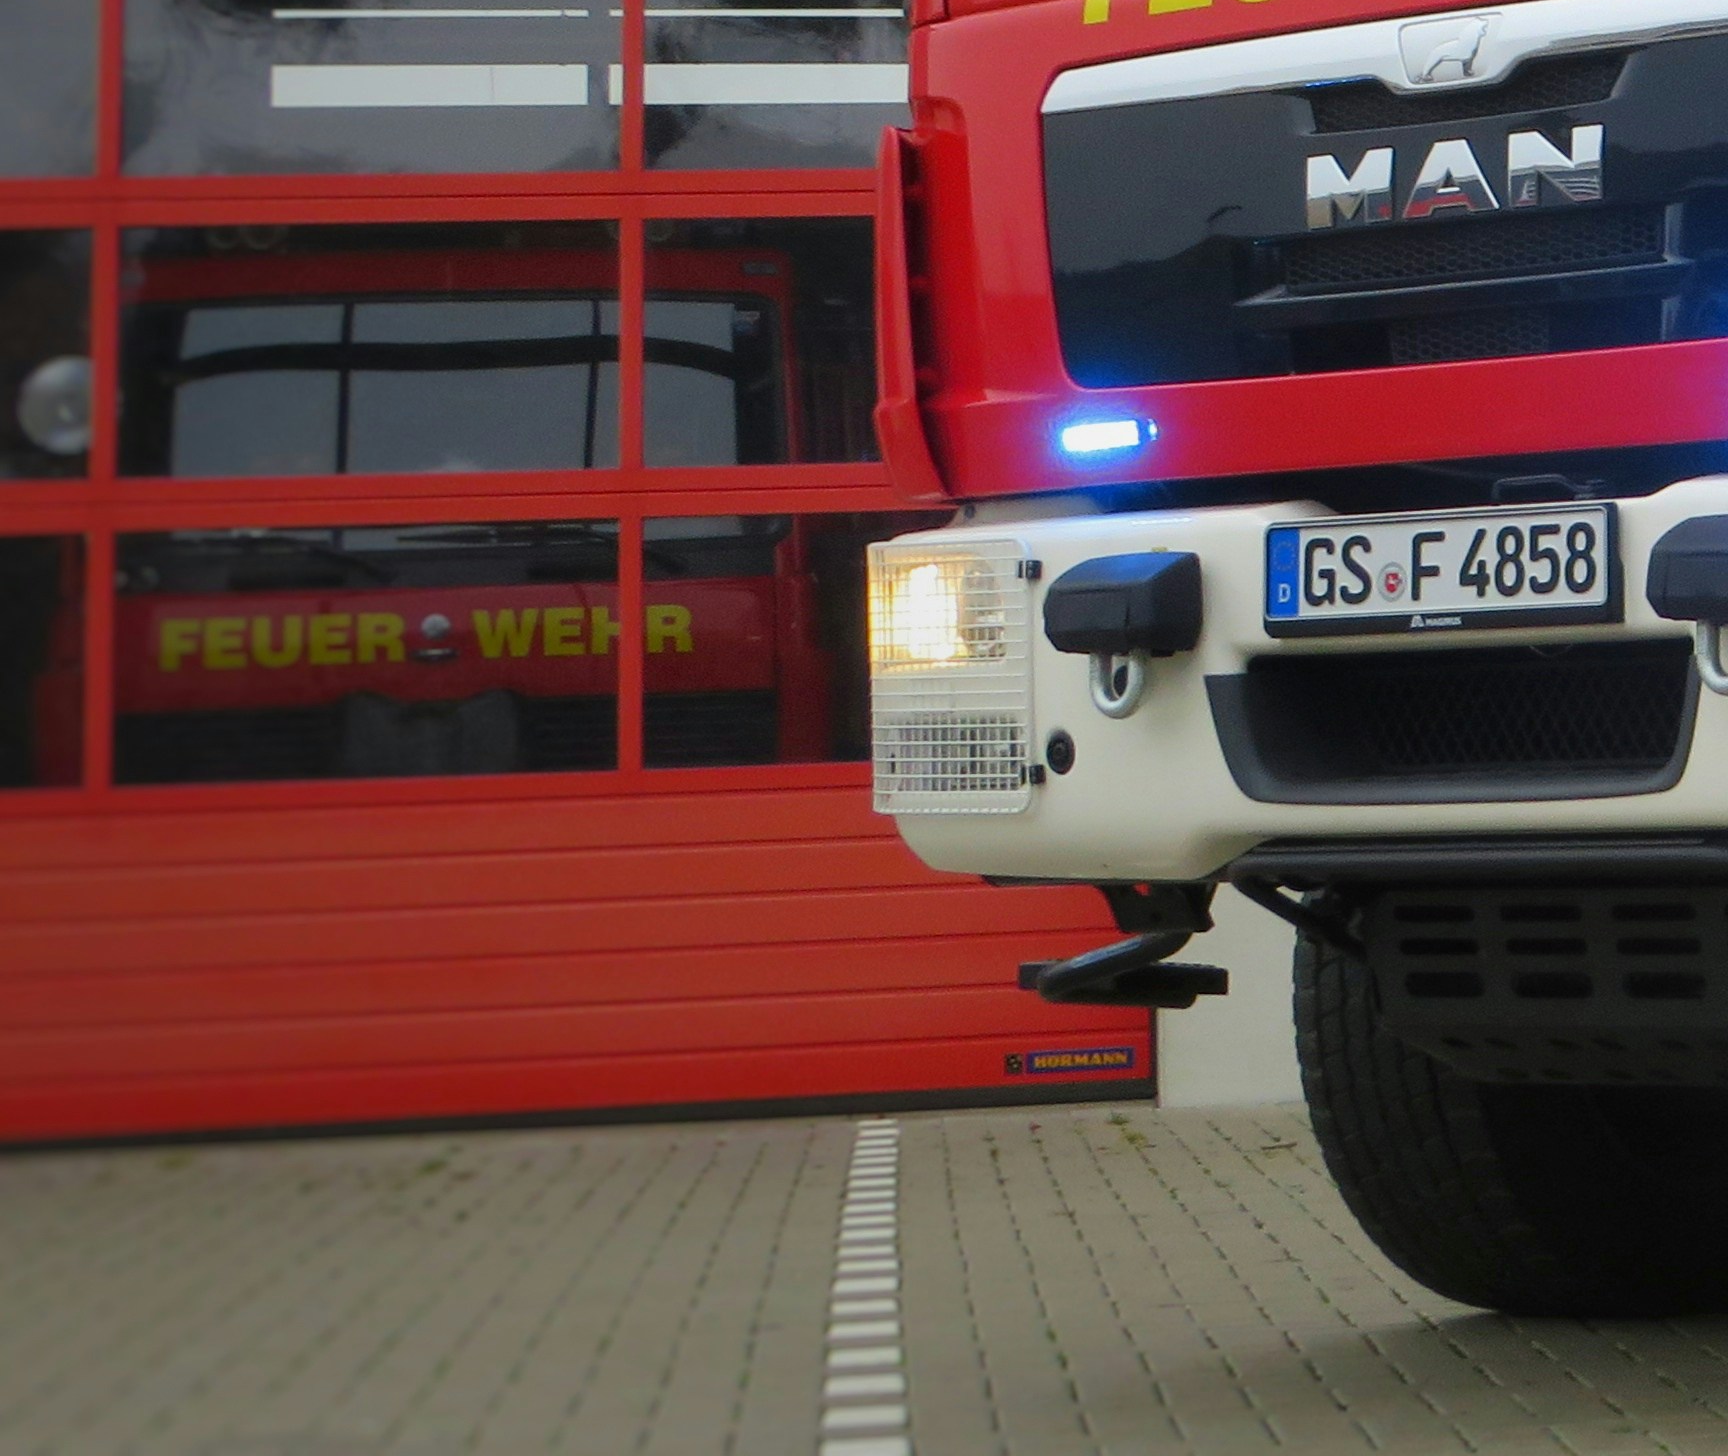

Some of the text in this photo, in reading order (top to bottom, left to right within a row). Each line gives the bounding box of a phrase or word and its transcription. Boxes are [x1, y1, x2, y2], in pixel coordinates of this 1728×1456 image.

[1306, 123, 1604, 230] MAN
[1278, 583, 1291, 604] D
[1303, 521, 1598, 607] GS F 4858
[158, 603, 694, 672] FEUER WEHR
